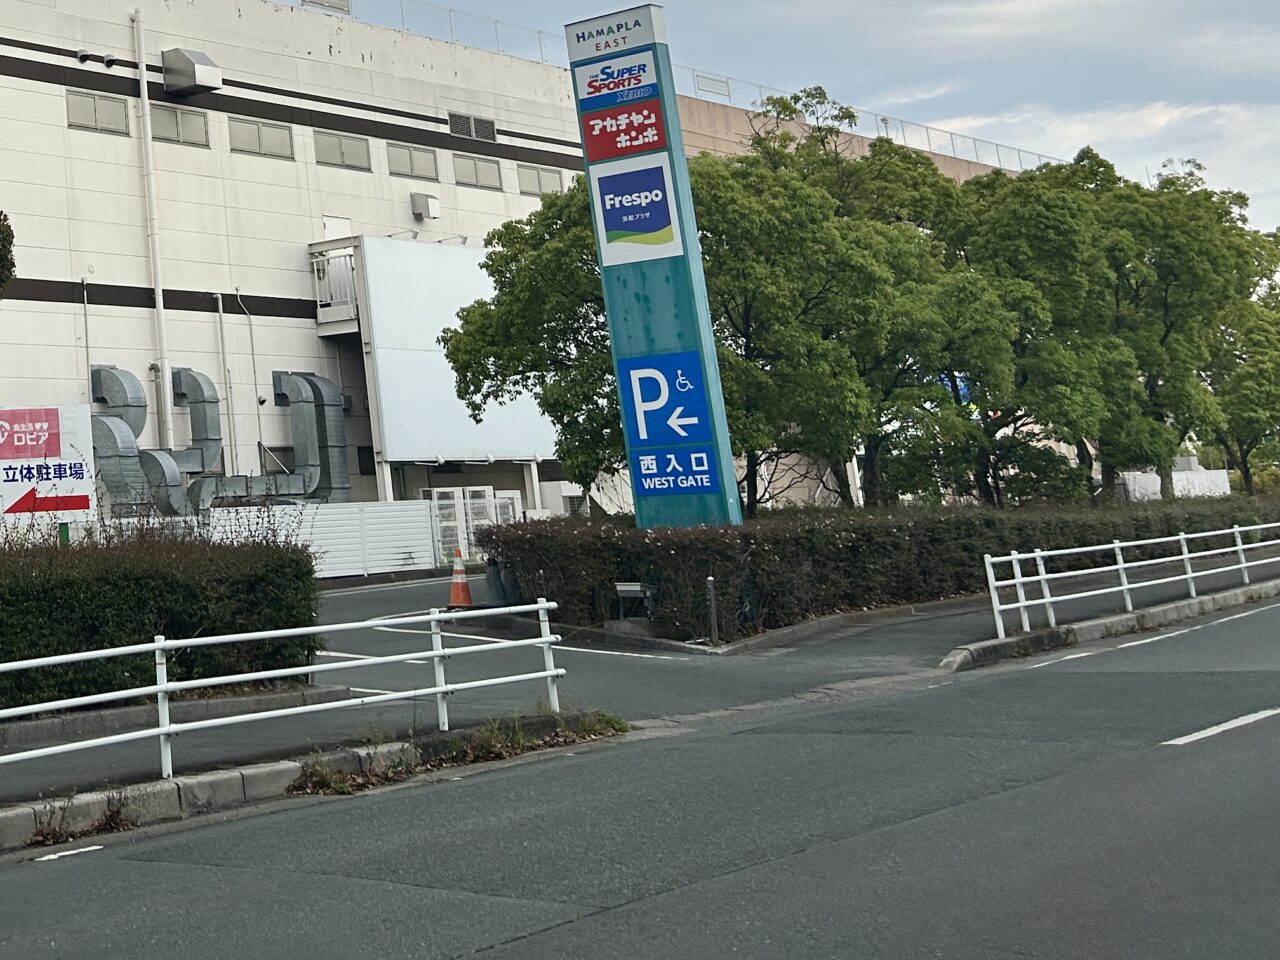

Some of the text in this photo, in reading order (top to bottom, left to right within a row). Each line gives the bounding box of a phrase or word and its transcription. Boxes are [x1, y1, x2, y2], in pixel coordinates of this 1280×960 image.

[576, 19, 642, 43] HAMAPLA
[595, 36, 628, 51] EAST
[600, 63, 647, 82] SUPER
[587, 75, 642, 95] SPORTS
[616, 86, 652, 102] XEBIO
[589, 109, 656, 135] アカチャン
[604, 189, 663, 210] Frespo
[622, 212, 651, 223] 浜松プラザ
[630, 368, 669, 440] P
[14, 431, 49, 446] ロピア
[3, 462, 85, 483] 立体駐車場
[642, 474, 711, 489] WEST GATE
